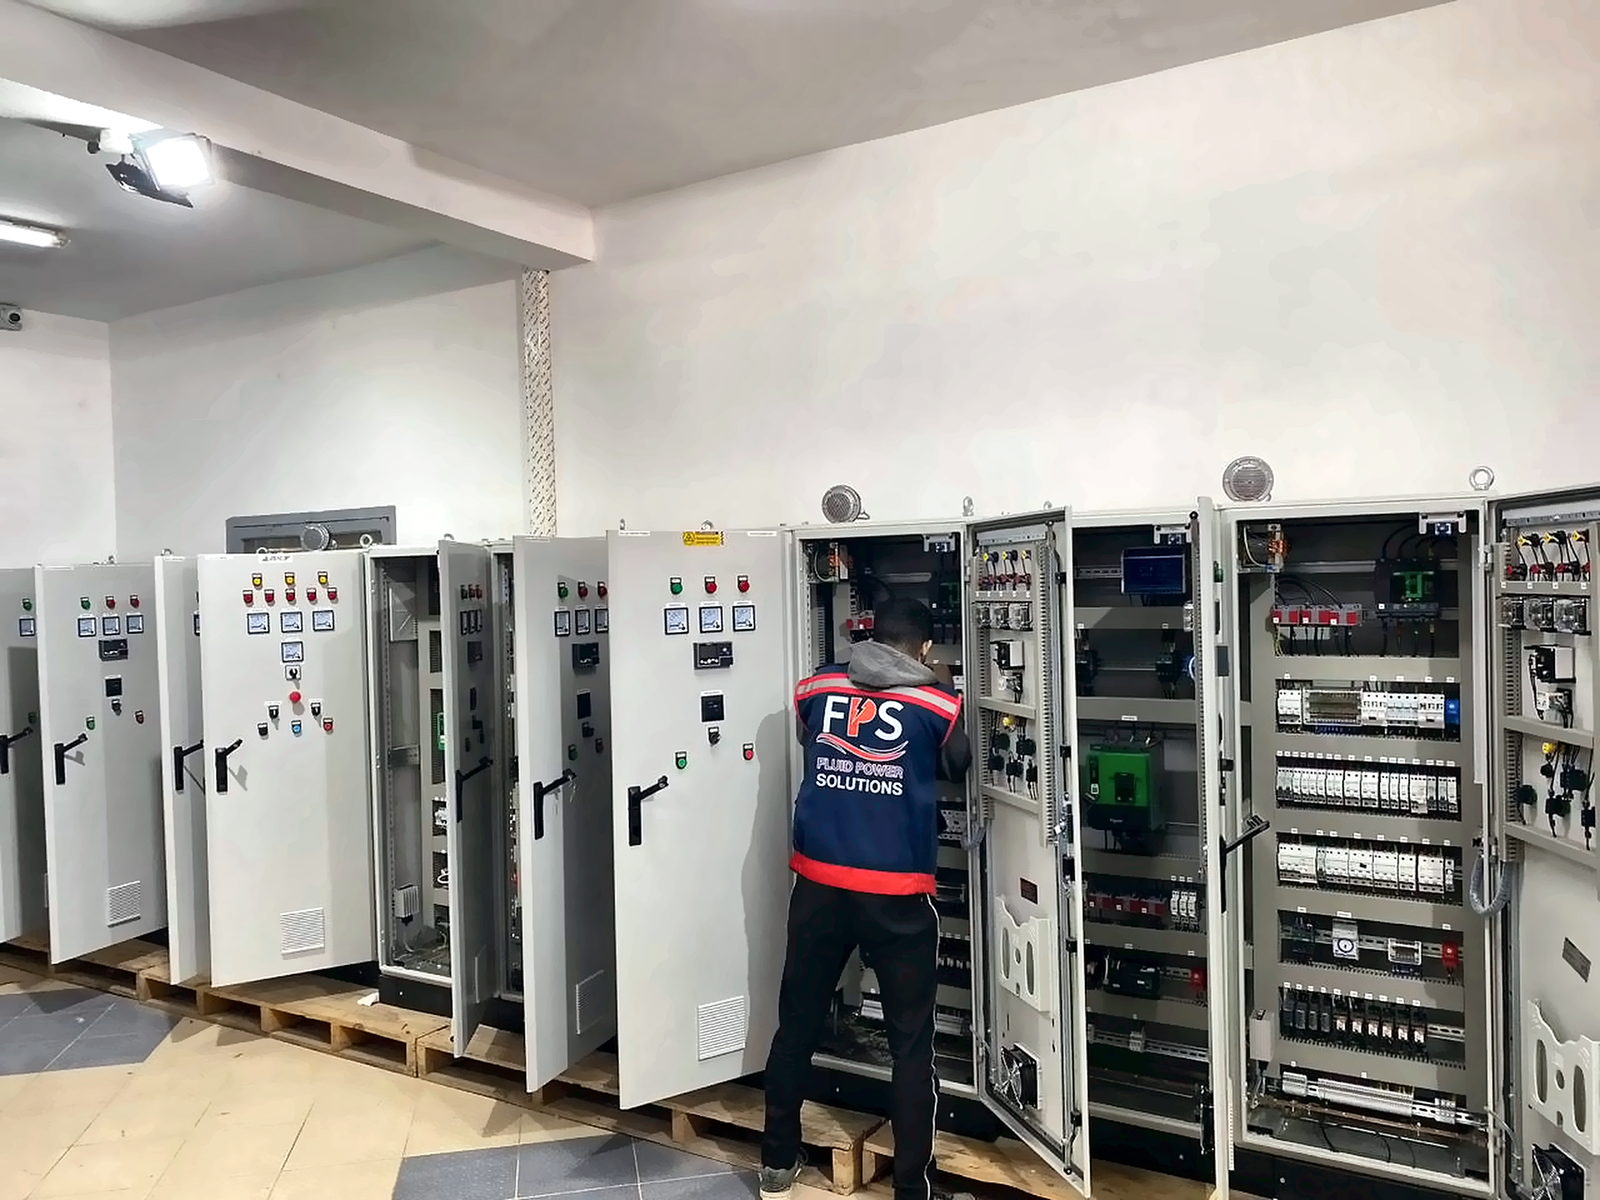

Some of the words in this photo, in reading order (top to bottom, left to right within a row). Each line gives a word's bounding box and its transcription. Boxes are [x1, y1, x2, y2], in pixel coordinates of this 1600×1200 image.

[823, 695, 904, 741] FPS
[816, 757, 854, 773] FLUID
[855, 762, 904, 779] POWER
[816, 773, 903, 796] SOLUTIONS
